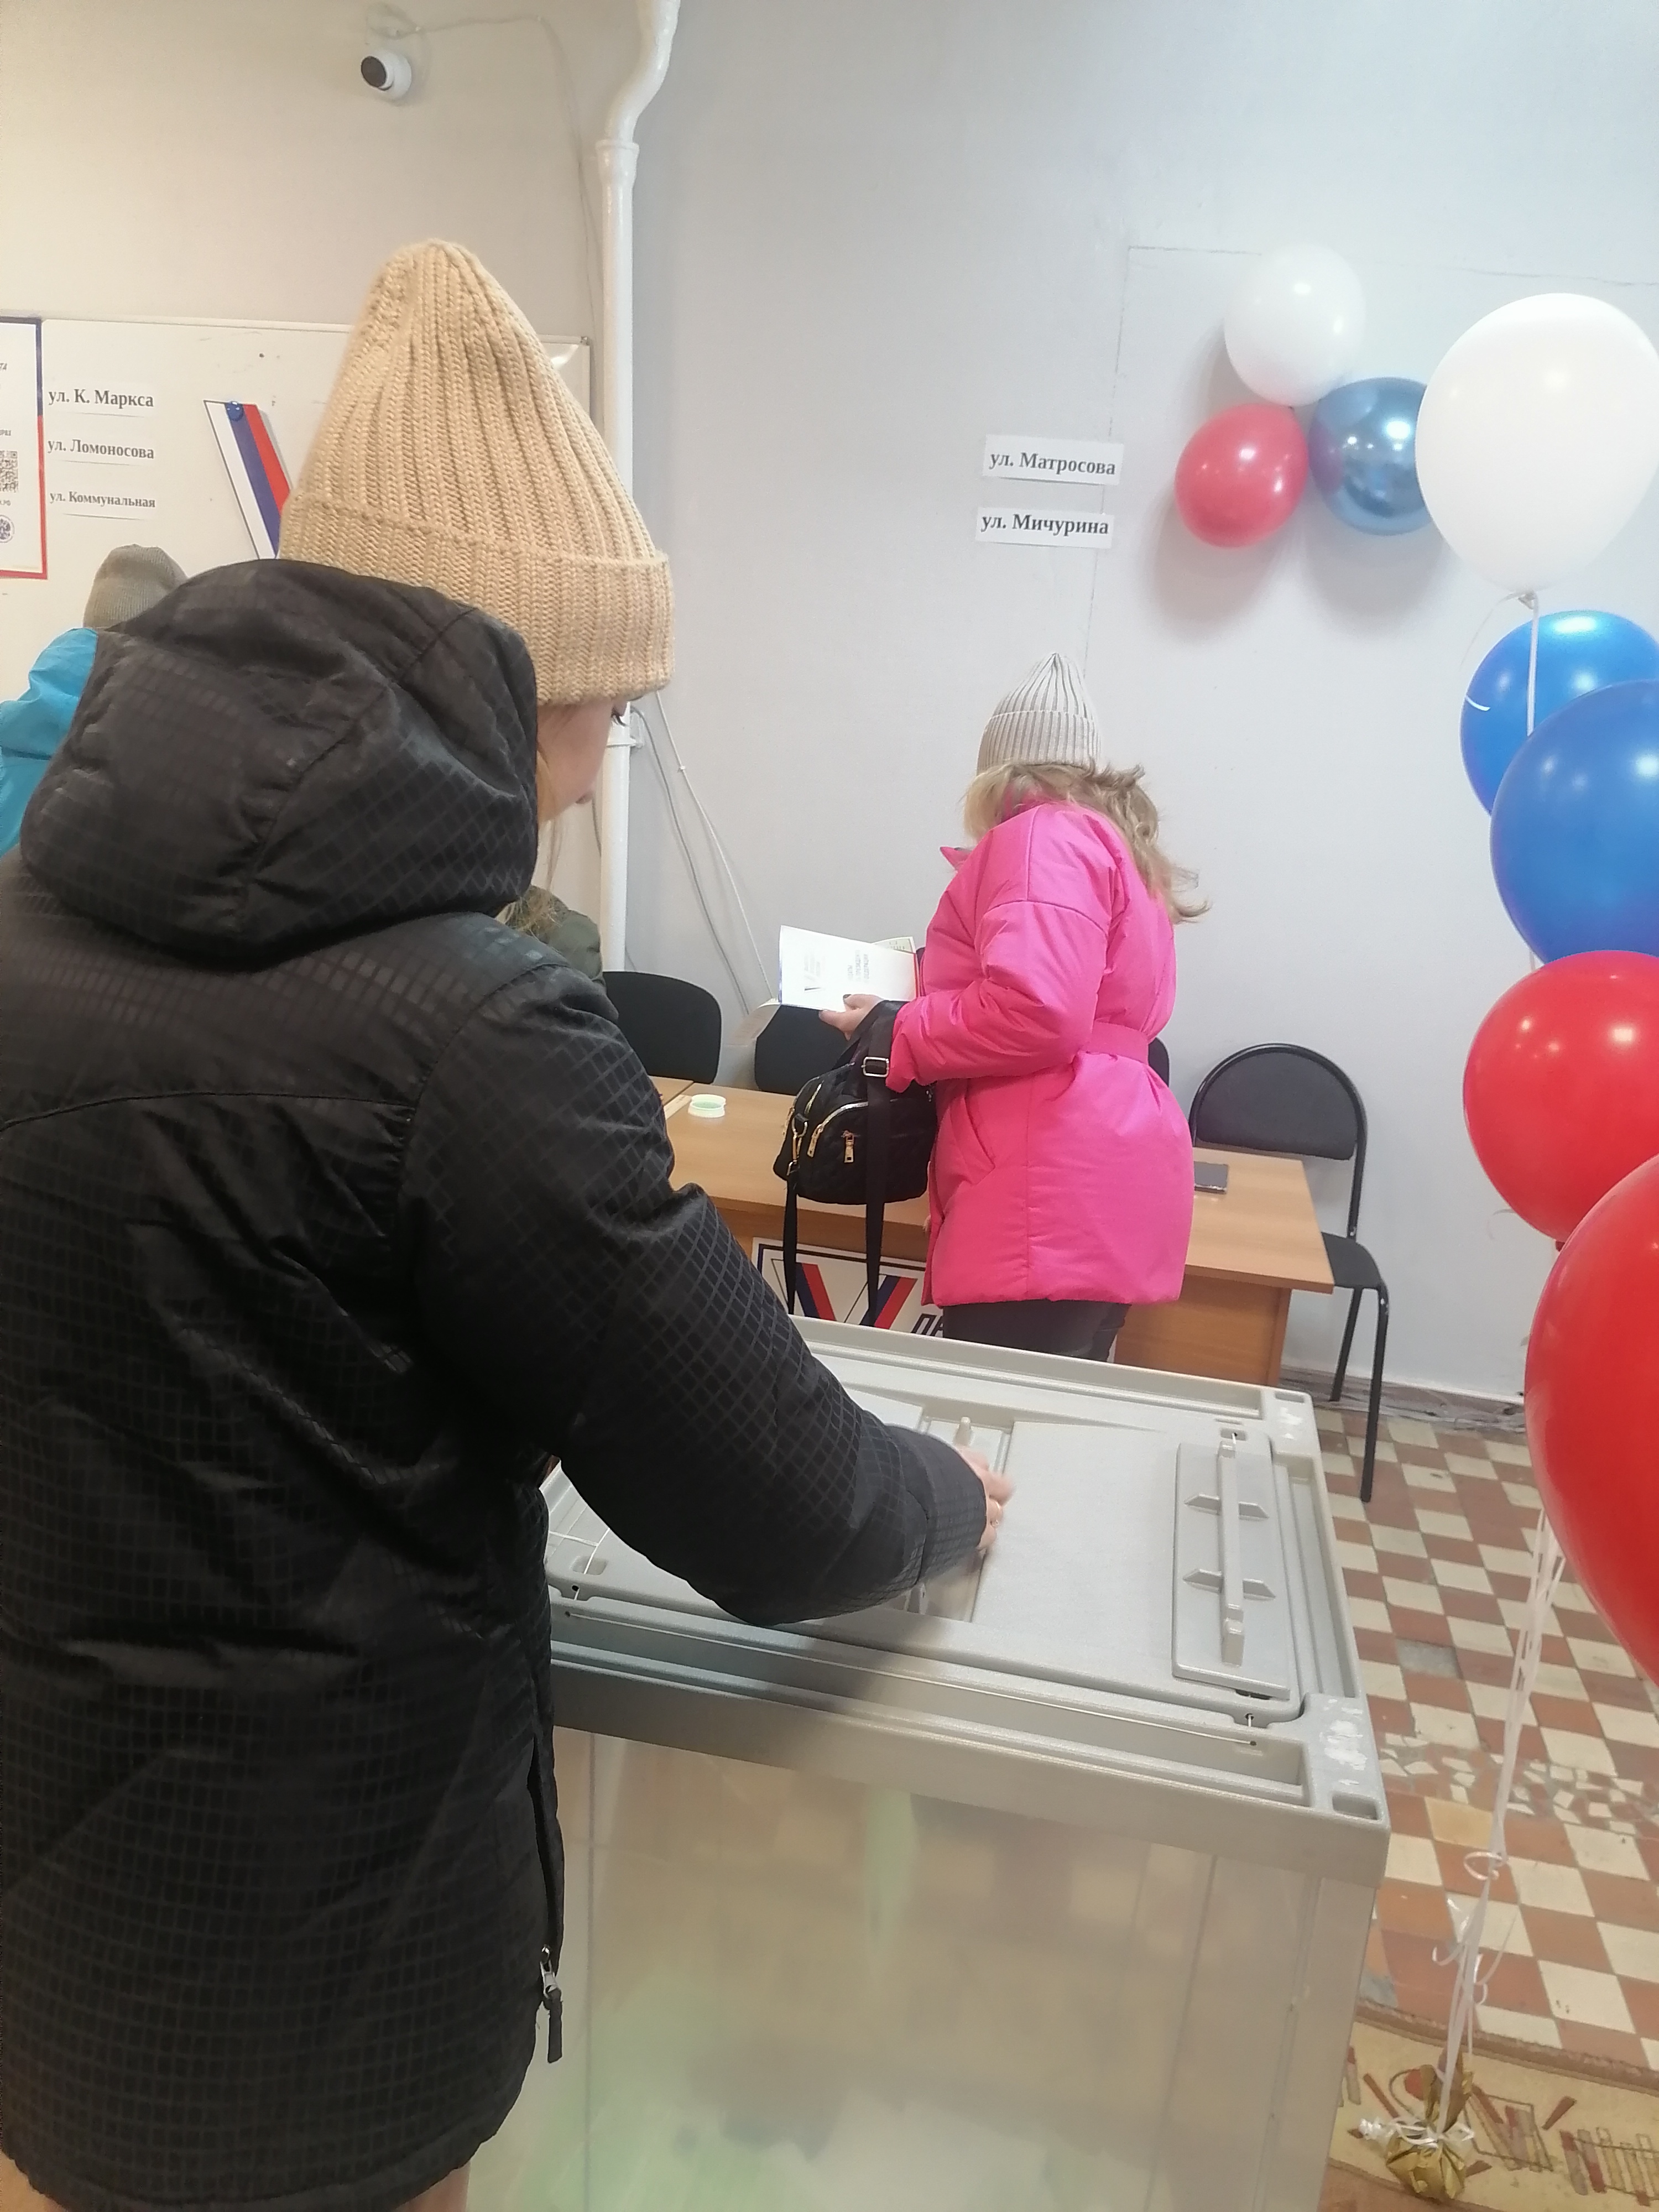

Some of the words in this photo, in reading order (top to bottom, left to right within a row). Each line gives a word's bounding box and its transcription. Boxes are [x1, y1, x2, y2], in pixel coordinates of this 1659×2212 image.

[48, 391, 70, 405] ул.
[74, 389, 90, 404] К.
[94, 389, 154, 409] Маркса
[48, 440, 66, 454] ул.
[70, 439, 154, 458] Ломоносова
[989, 453, 1014, 469] ул.
[1019, 452, 1116, 475] Матросова
[49, 493, 66, 504] ул.
[69, 491, 156, 508] Коммунальная
[980, 515, 1007, 533] ул.
[1012, 514, 1109, 536] Мичурина
